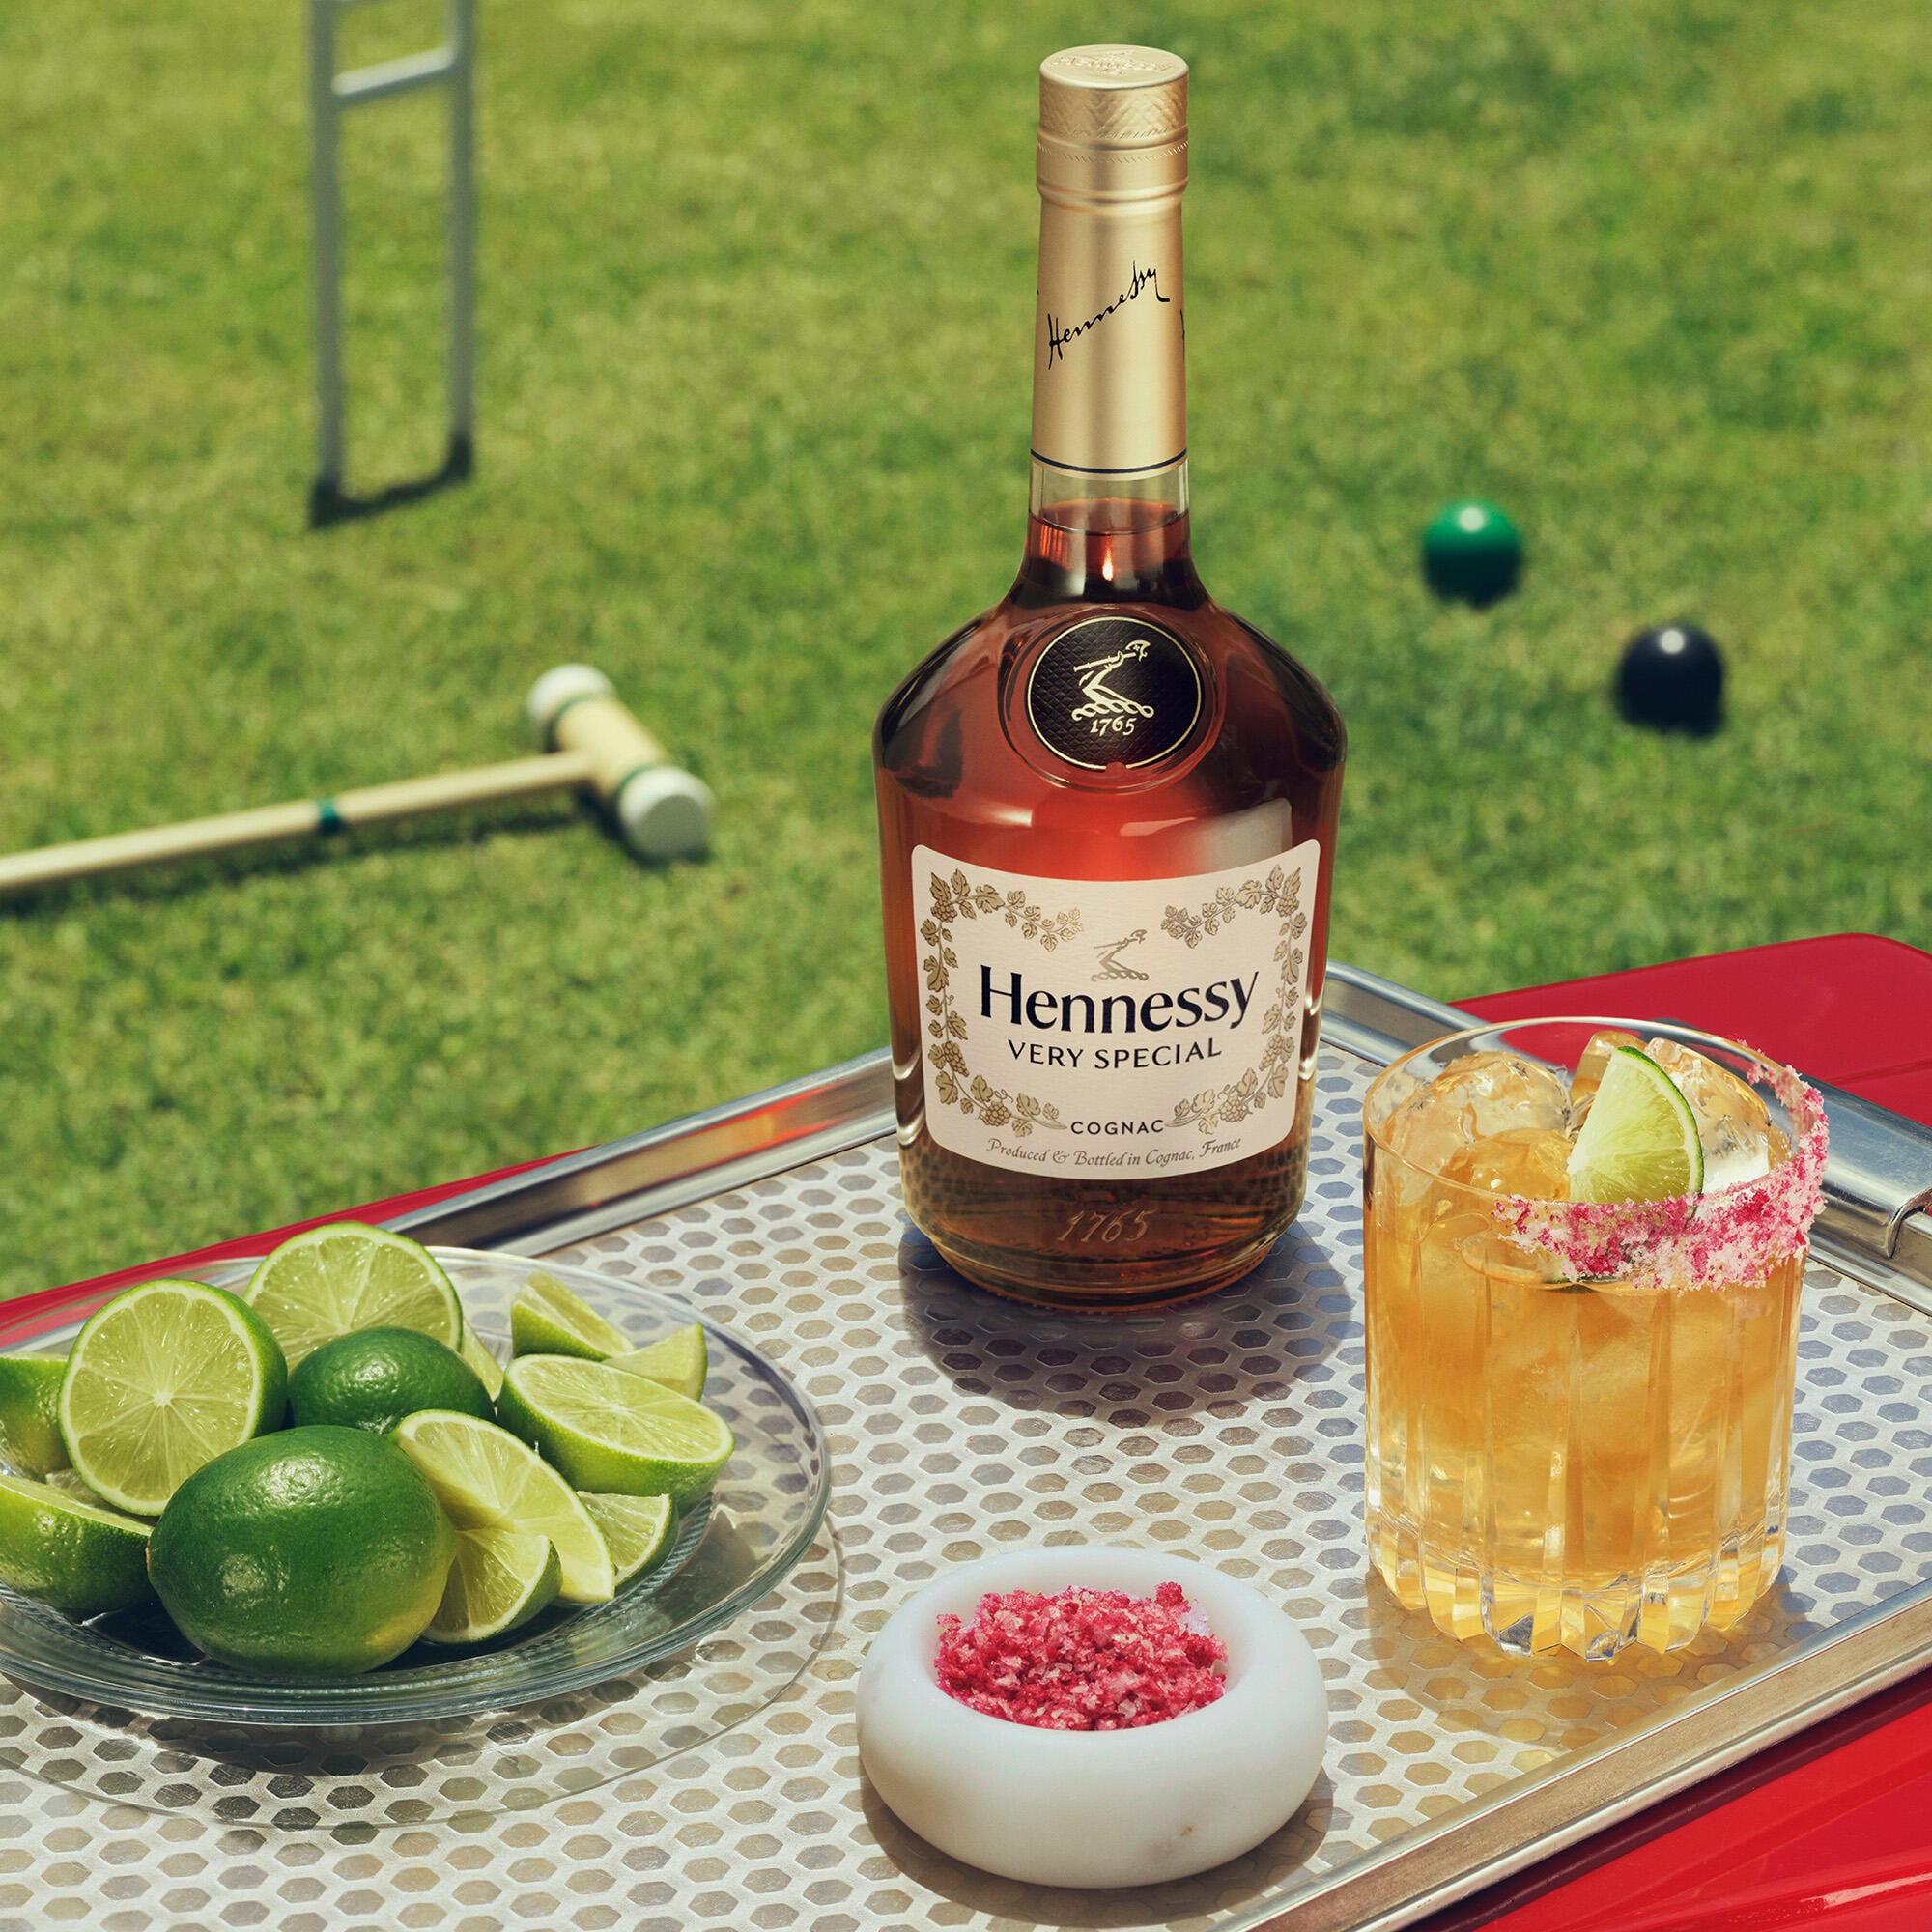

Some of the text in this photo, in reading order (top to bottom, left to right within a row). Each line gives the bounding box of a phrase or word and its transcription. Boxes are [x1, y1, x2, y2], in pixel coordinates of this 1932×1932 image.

[1089, 715, 1138, 737] 1765
[980, 963, 1260, 1035] Hennessy
[1008, 1037, 1223, 1070] VERY SPECIAL
[1070, 1119, 1165, 1136] COGNAC
[986, 1137, 1051, 1162] Produced
[1052, 1150, 1070, 1165] &
[1073, 1150, 1127, 1167] Bottled
[1127, 1152, 1141, 1166] in
[1199, 1137, 1241, 1158] France
[1057, 1209, 1156, 1244] 1765
